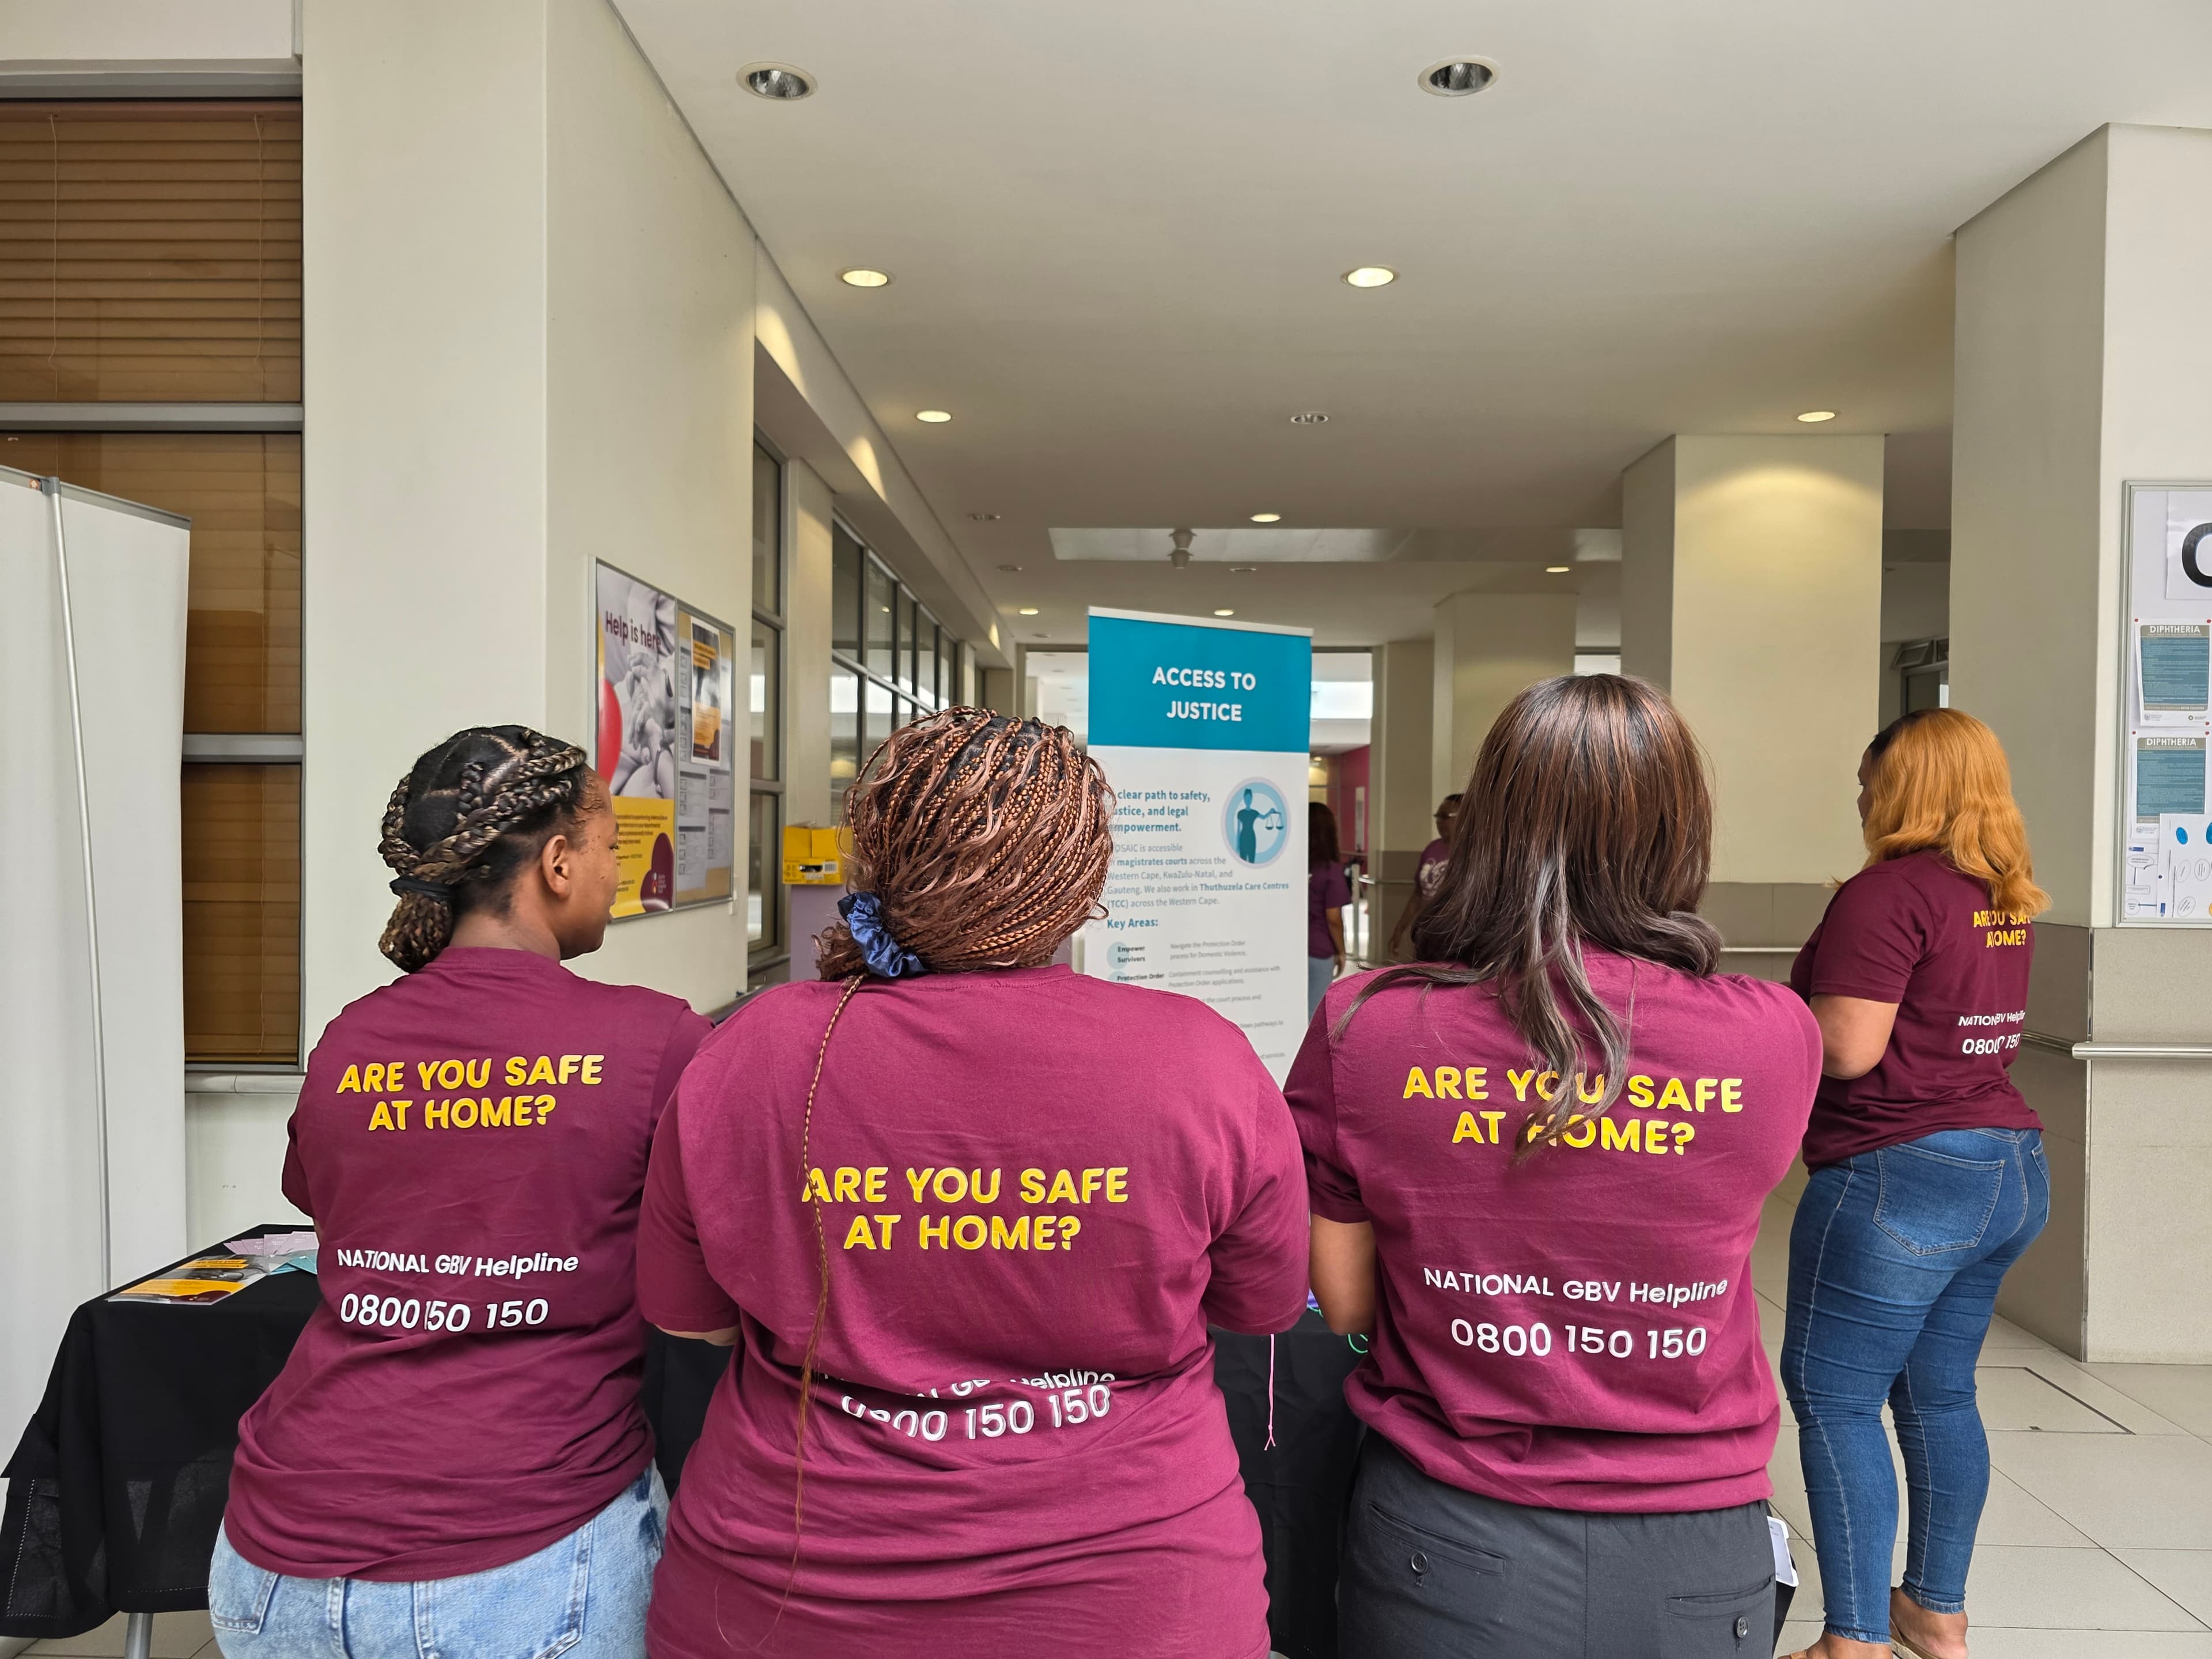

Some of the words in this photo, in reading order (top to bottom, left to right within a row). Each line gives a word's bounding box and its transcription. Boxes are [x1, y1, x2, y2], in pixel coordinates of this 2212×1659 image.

[605, 610, 628, 646] Help
[631, 618, 638, 643] is
[641, 624, 661, 650] here
[1152, 666, 1226, 689] ACCESS
[1230, 672, 1256, 691] TO
[1166, 700, 1243, 722] JUSTICE
[2146, 738, 2196, 746] DIPHTHERIA
[1117, 789, 1142, 800] clear
[1145, 790, 1166, 802] path
[1169, 790, 1178, 800] to
[1180, 791, 1210, 803] safety,
[1112, 805, 1145, 818] ustice,
[1147, 806, 1165, 816] and
[1168, 806, 1189, 819] legal
[1114, 844, 1139, 853] OSAIC
[1140, 844, 1146, 853] is
[1147, 843, 1183, 853] accessible
[1117, 857, 1164, 868] magistrates
[1213, 857, 1226, 865] the
[1108, 872, 1139, 880] Western
[1141, 871, 1162, 881] Cape,
[1163, 870, 1217, 880] KwaZulu-Natal,
[1218, 869, 1233, 878] and
[1107, 886, 1142, 896] Gauteng.
[1144, 885, 1156, 893] We
[1157, 884, 1171, 893] also
[1172, 883, 1189, 892] work
[1191, 883, 1198, 892] in
[1199, 882, 1243, 891] Thuthuzela
[1245, 882, 1261, 891] Care
[1263, 882, 1289, 890] Centres
[1107, 899, 1128, 909] (TCC)
[1156, 899, 1167, 907] the
[1169, 897, 1196, 906] Western
[1198, 896, 1220, 906] Cape.
[1107, 919, 1126, 931] Key
[1128, 918, 1158, 928] Areas:
[1118, 945, 1145, 953] Empower
[1994, 929, 2027, 946] OME?
[1117, 974, 1148, 982] Protection
[337, 1062, 405, 1093] ARE
[418, 1058, 492, 1090] YOU
[505, 1055, 605, 1086] SAFE
[1403, 1066, 1489, 1100] ARE
[1628, 1075, 1743, 1113] SAFE
[368, 1100, 413, 1131] AT
[425, 1094, 556, 1129] HOME?
[1452, 1111, 1506, 1144] AT
[801, 1166, 888, 1203] ARE
[906, 1167, 1001, 1204] YOU
[1020, 1167, 1128, 1204] SAFE
[843, 1214, 902, 1250] AT
[919, 1214, 1081, 1251] HOME?
[337, 1249, 430, 1273] NATIONAL
[435, 1255, 472, 1275] GBV
[474, 1252, 579, 1280] Helpline
[1423, 1267, 1554, 1296] NATIONAL
[1562, 1280, 1621, 1302] GBV
[1630, 1279, 1728, 1309] Helpline
[340, 1293, 421, 1329] 0800
[487, 1298, 548, 1328] 150
[1451, 1319, 1551, 1357] 0800
[1565, 1325, 1633, 1358] 150
[1647, 1327, 1706, 1359] 150
[965, 1400, 1035, 1440] 150
[1048, 1384, 1111, 1428] 150
